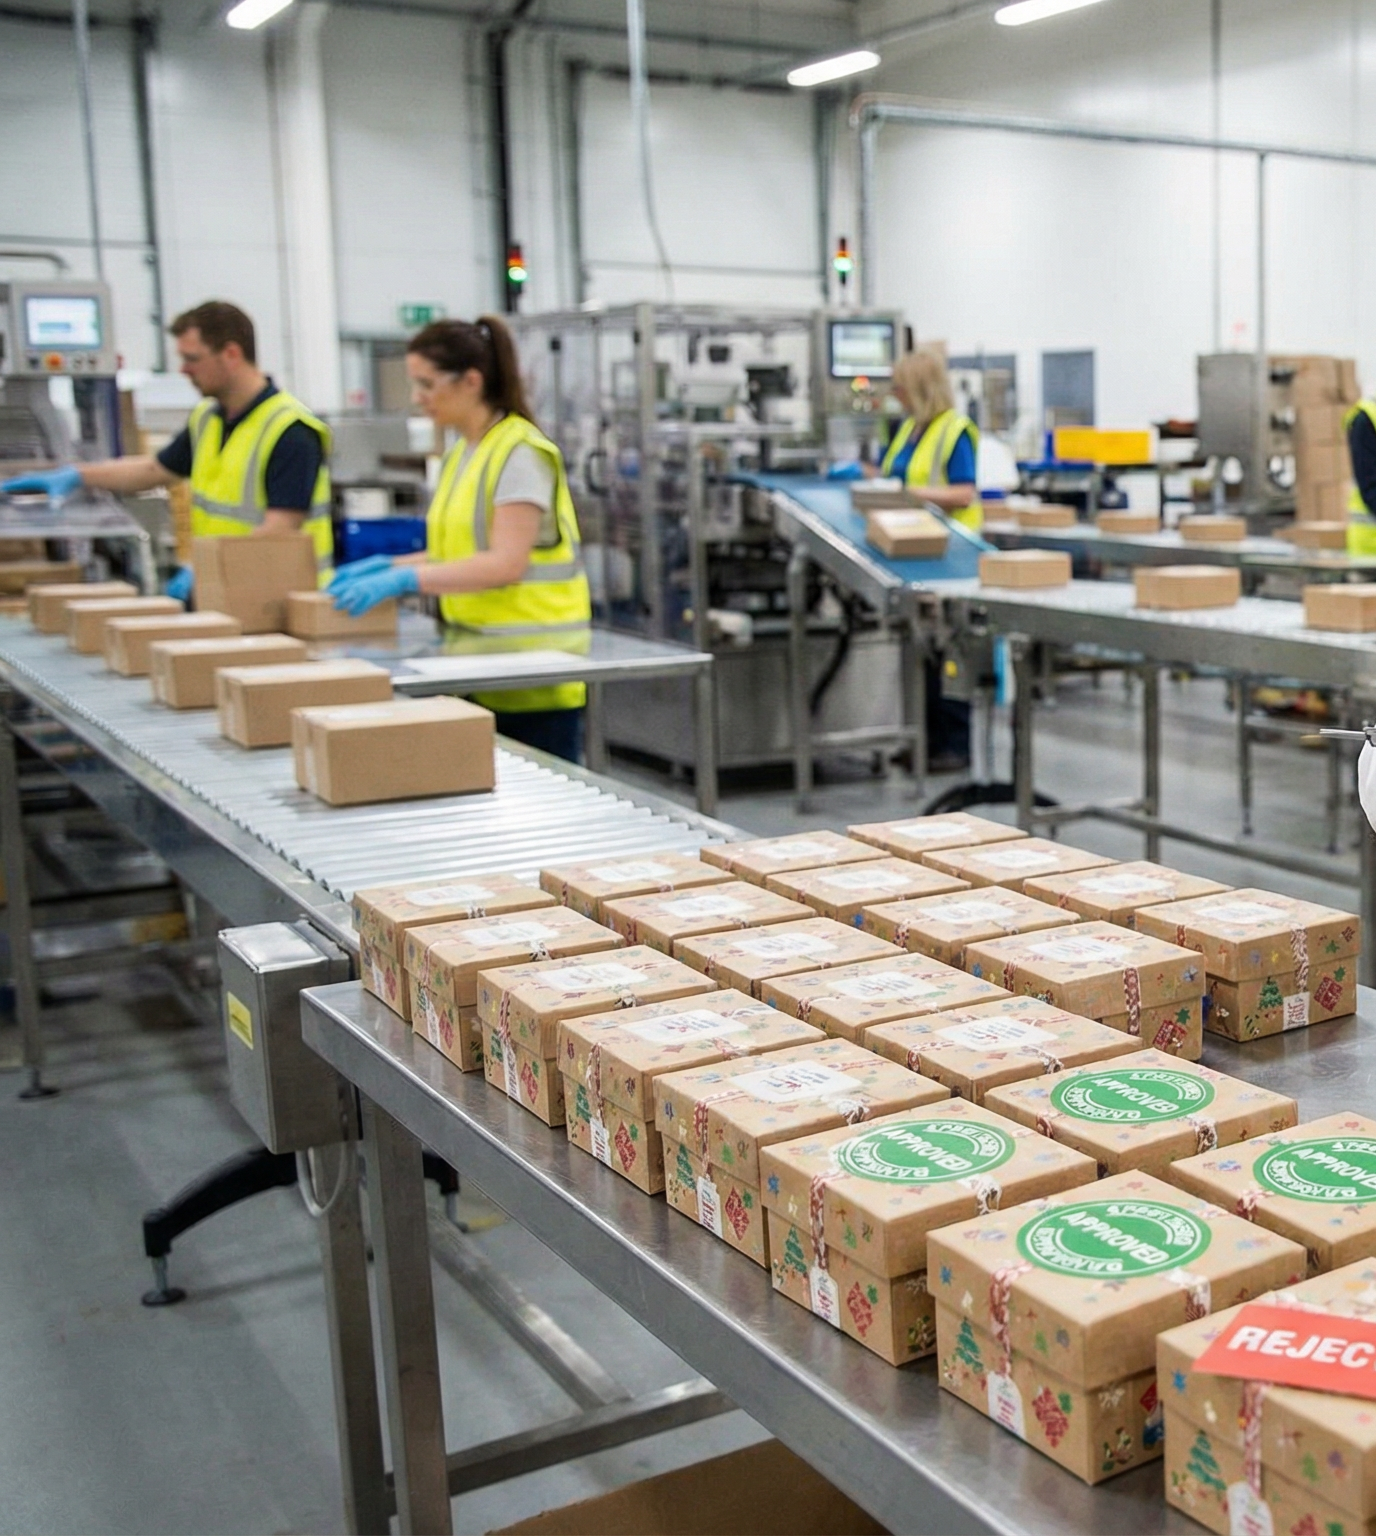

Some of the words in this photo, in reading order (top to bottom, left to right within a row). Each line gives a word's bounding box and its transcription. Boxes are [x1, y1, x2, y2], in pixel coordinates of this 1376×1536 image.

[1091, 1078, 1180, 1113] APPROVED
[881, 1129, 973, 1171] APPROVED
[1059, 1211, 1170, 1264] APPROVED
